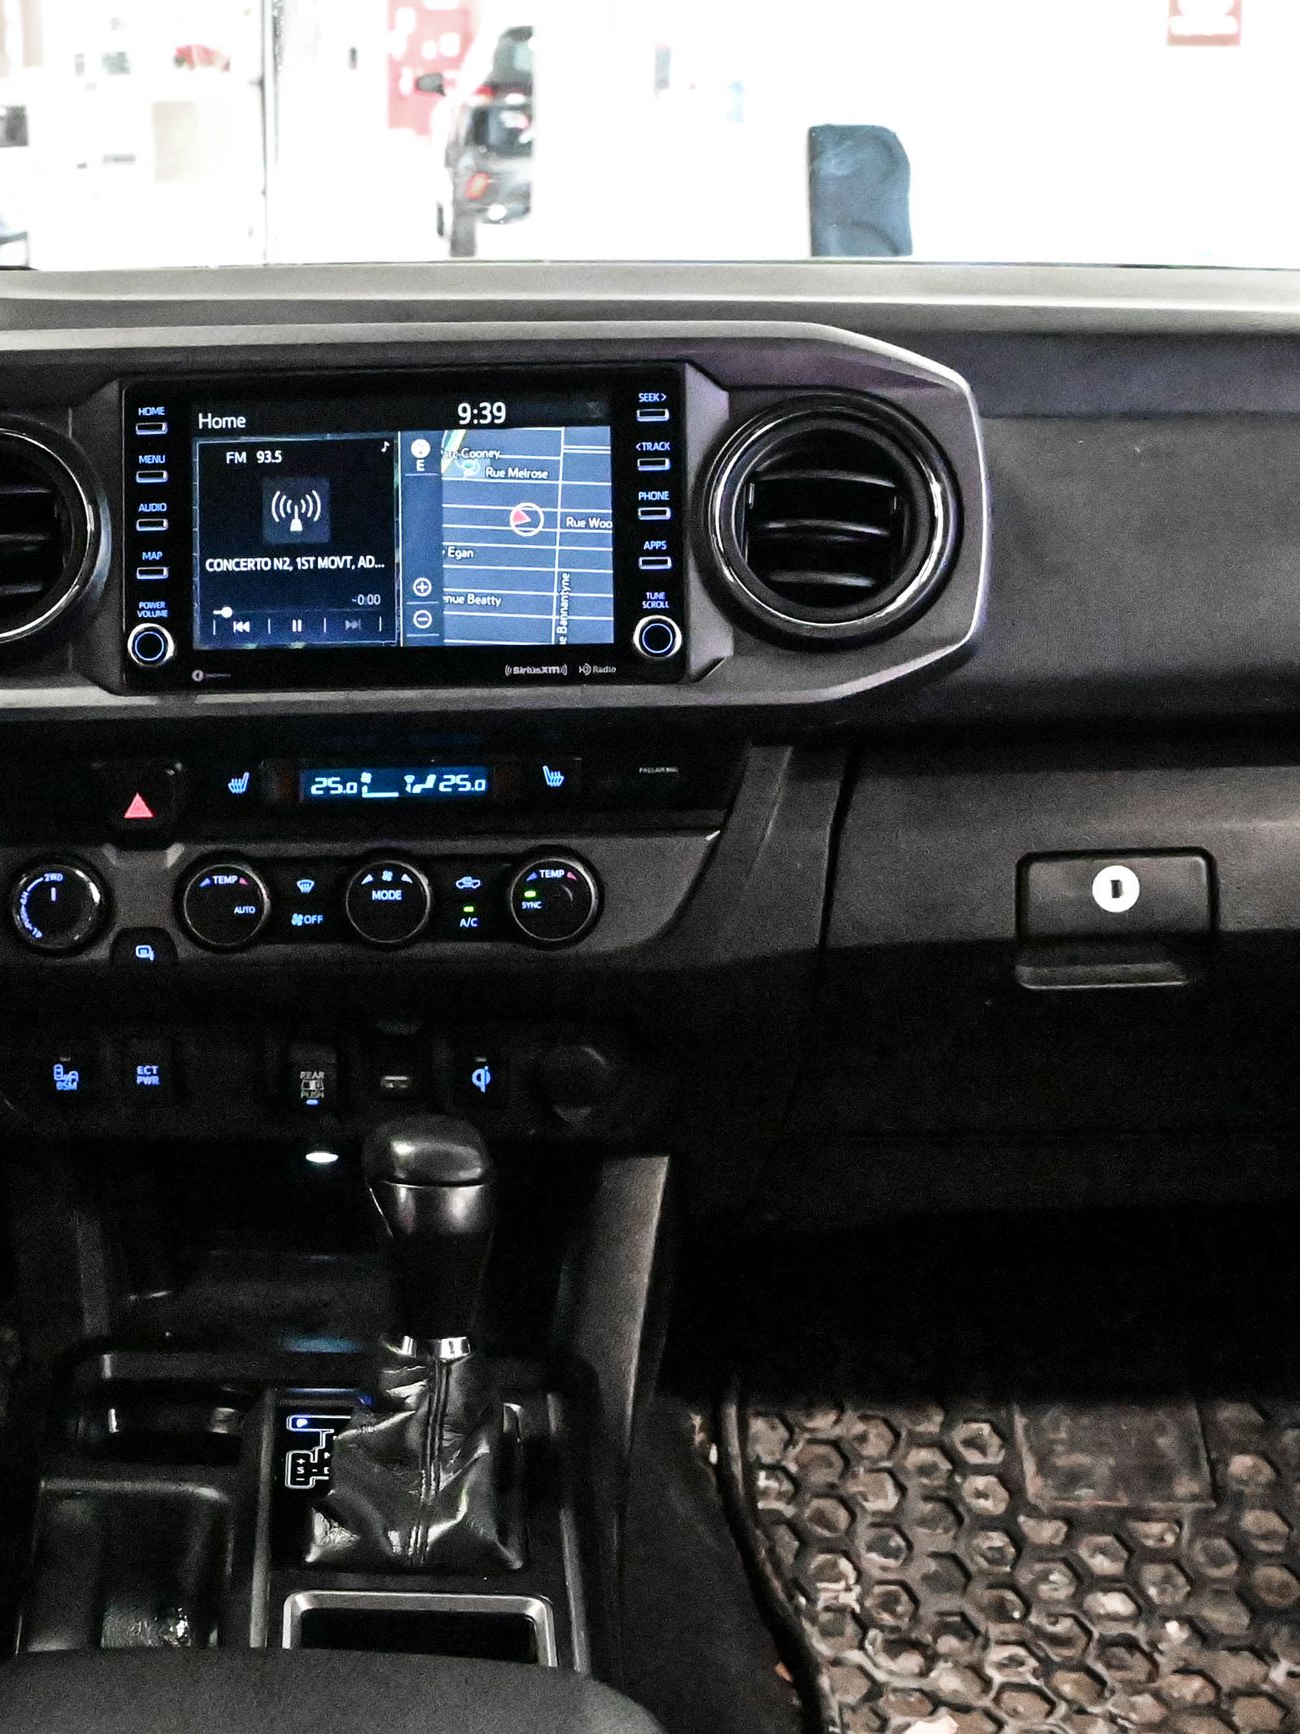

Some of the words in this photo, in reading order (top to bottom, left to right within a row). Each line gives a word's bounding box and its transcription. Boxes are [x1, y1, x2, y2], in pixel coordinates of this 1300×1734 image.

[138, 406, 166, 416] HOME
[457, 401, 507, 425] 9:39
[198, 412, 247, 430] Home
[138, 454, 166, 464] MENU
[226, 451, 247, 464] FM
[256, 450, 283, 464] 93.5
[416, 459, 425, 472] E
[485, 466, 506, 479] Rue
[508, 467, 549, 480] Melrose
[638, 490, 670, 501] PHONE
[138, 502, 168, 513] AUDIO
[566, 516, 587, 528] Rue
[643, 540, 668, 550] APPS
[142, 551, 163, 561] MAP
[447, 546, 474, 560] Egan
[205, 557, 272, 572] CONCERTO
[273, 557, 293, 571] N2,
[296, 556, 316, 570] 1ST
[317, 555, 355, 570] MOVT,
[467, 593, 502, 607] Beatty
[645, 591, 666, 600] TUNE
[138, 601, 166, 609] POWER
[642, 600, 670, 609] SCROLL
[137, 609, 169, 618] VOLUME
[311, 777, 358, 794] 25.0
[438, 774, 487, 792] 25.0
[540, 869, 565, 878] TEMP
[212, 875, 238, 884] TEMP
[372, 890, 402, 900] MODE
[234, 905, 256, 915] AUTO
[303, 914, 324, 924] OFF
[459, 917, 478, 928] A/C
[136, 1065, 159, 1075] ECT
[136, 1075, 160, 1085] PWR
